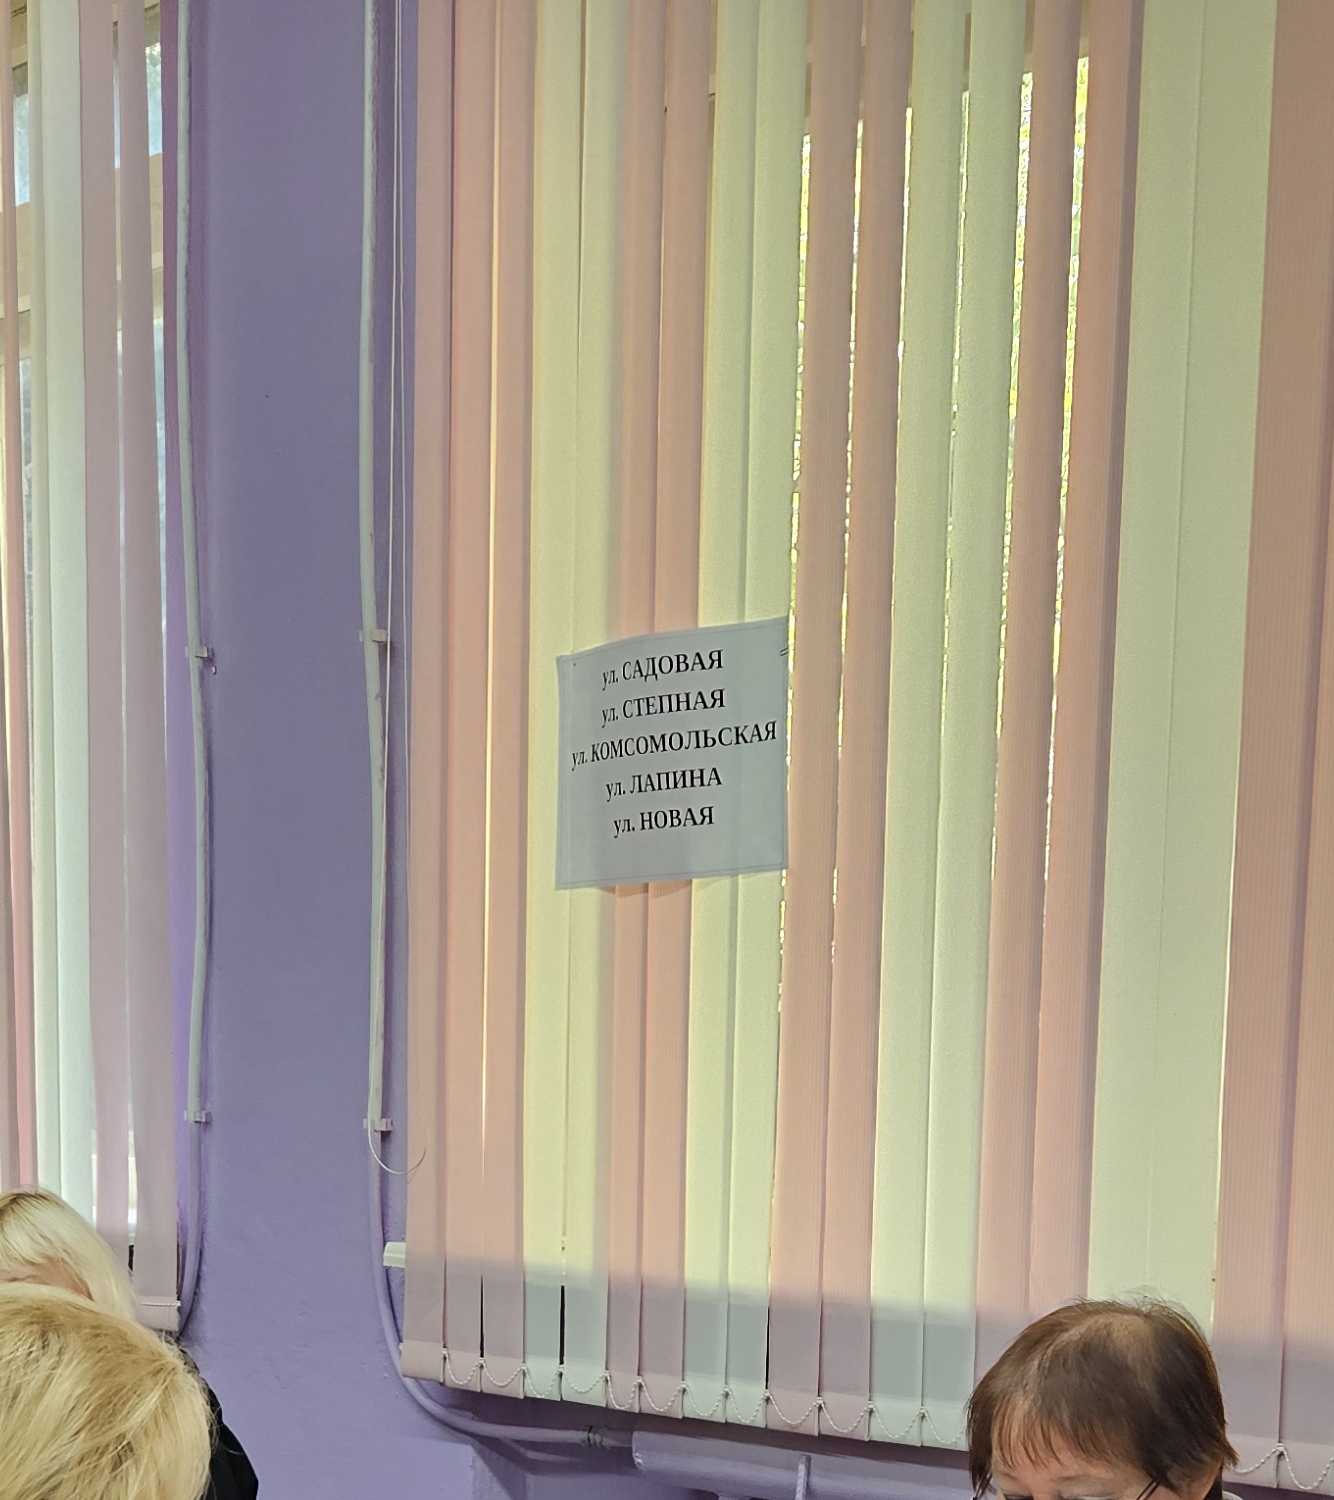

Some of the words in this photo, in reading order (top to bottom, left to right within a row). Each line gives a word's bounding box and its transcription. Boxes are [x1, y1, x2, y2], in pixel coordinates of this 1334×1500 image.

[601, 668, 619, 691] ул.
[622, 649, 723, 682] САДОВАЯ
[601, 706, 619, 728] ул.
[622, 688, 726, 719] СТЕПНАЯ
[571, 749, 588, 771] ул.
[590, 720, 778, 763] КОМСОМОЛЬСКАЯ
[606, 780, 626, 802] ул.
[630, 767, 722, 794] ЛАПИНА
[613, 817, 636, 838] ул.
[640, 806, 714, 831] НОВАЯ
